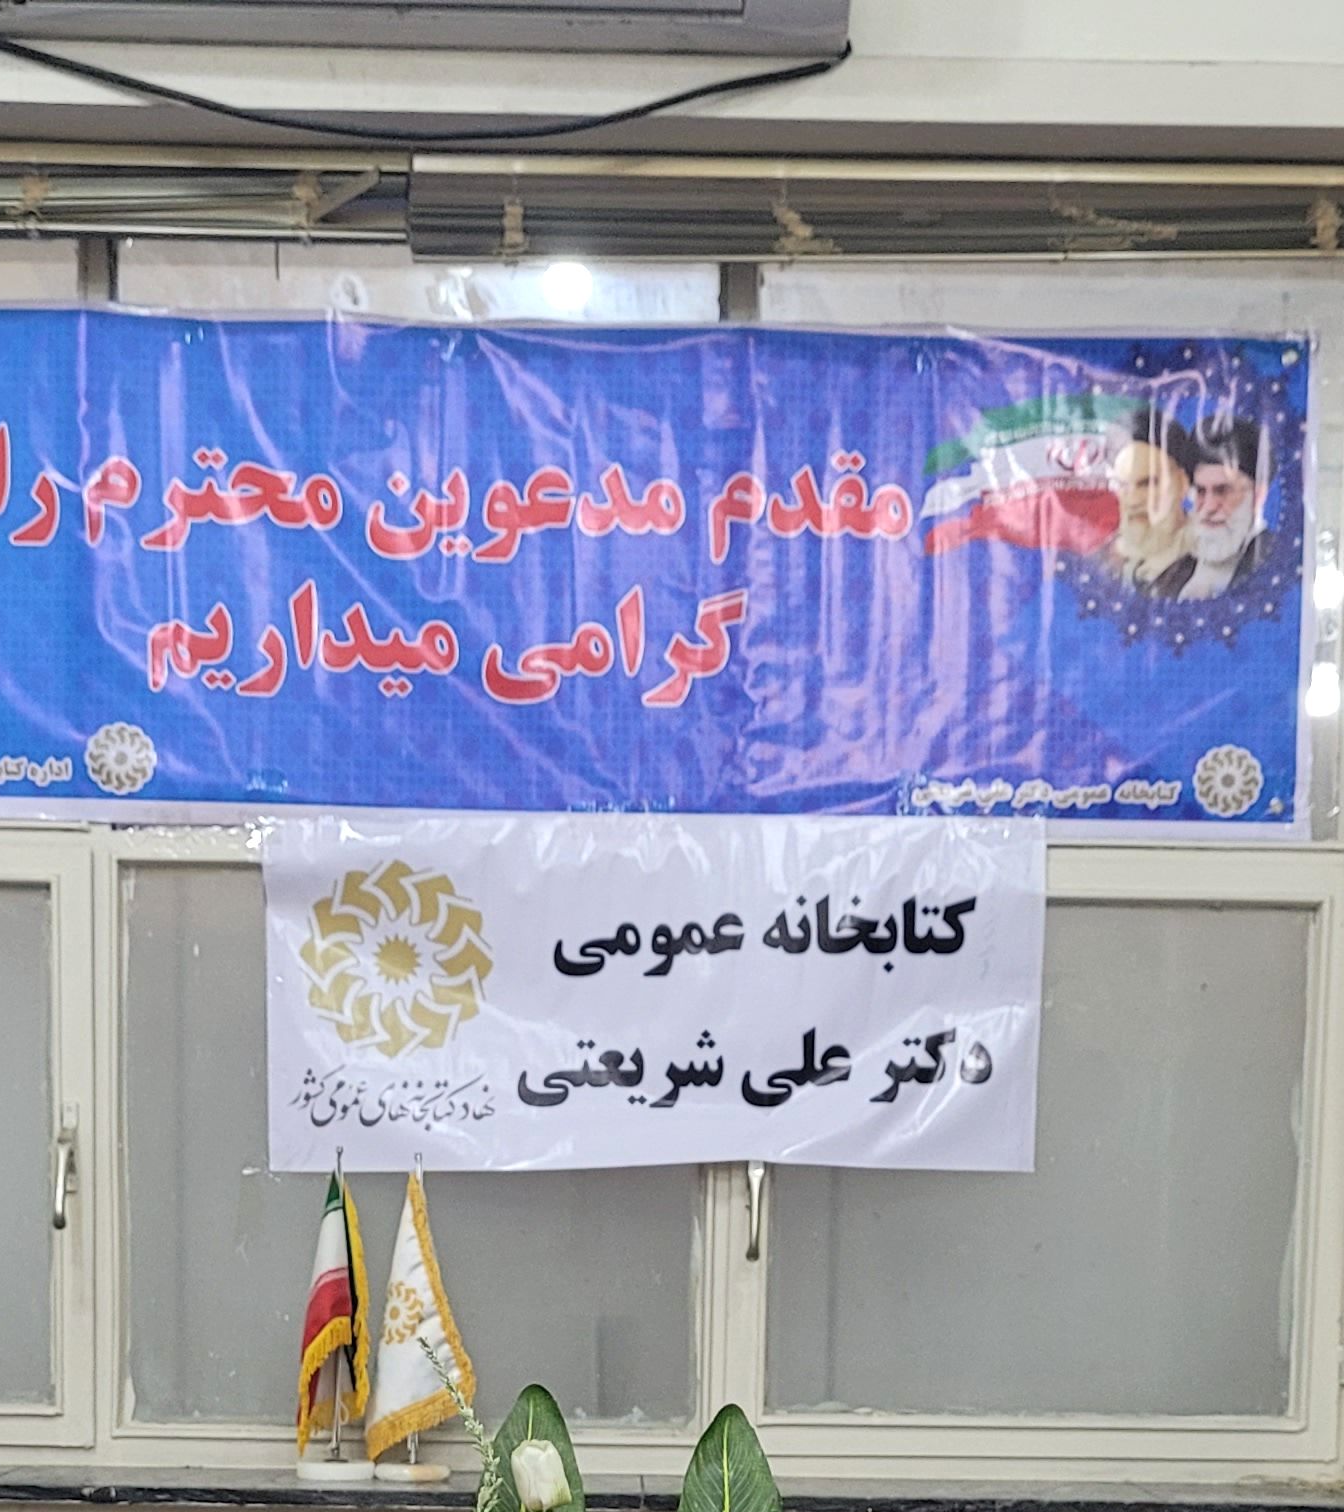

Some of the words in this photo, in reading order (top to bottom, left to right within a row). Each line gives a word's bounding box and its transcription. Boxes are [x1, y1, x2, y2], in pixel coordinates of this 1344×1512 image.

[83, 446, 344, 551] محترم
[365, 463, 686, 563] مدعوین
[708, 448, 913, 565] مقدم
[147, 578, 458, 697] میداریم
[483, 583, 749, 707] گرامی
[27, 756, 73, 787] اداره
[1011, 778, 1053, 808] دکتر
[1051, 783, 1113, 809] عمومی
[1113, 779, 1182, 810] کتابخانه
[553, 912, 746, 977] عمومی
[761, 893, 978, 974] کتابخانه
[287, 1063, 348, 1111] کشور
[516, 1029, 725, 1109] شریعتی
[740, 1026, 854, 1108] علی
[869, 1026, 994, 1104] دکتر
